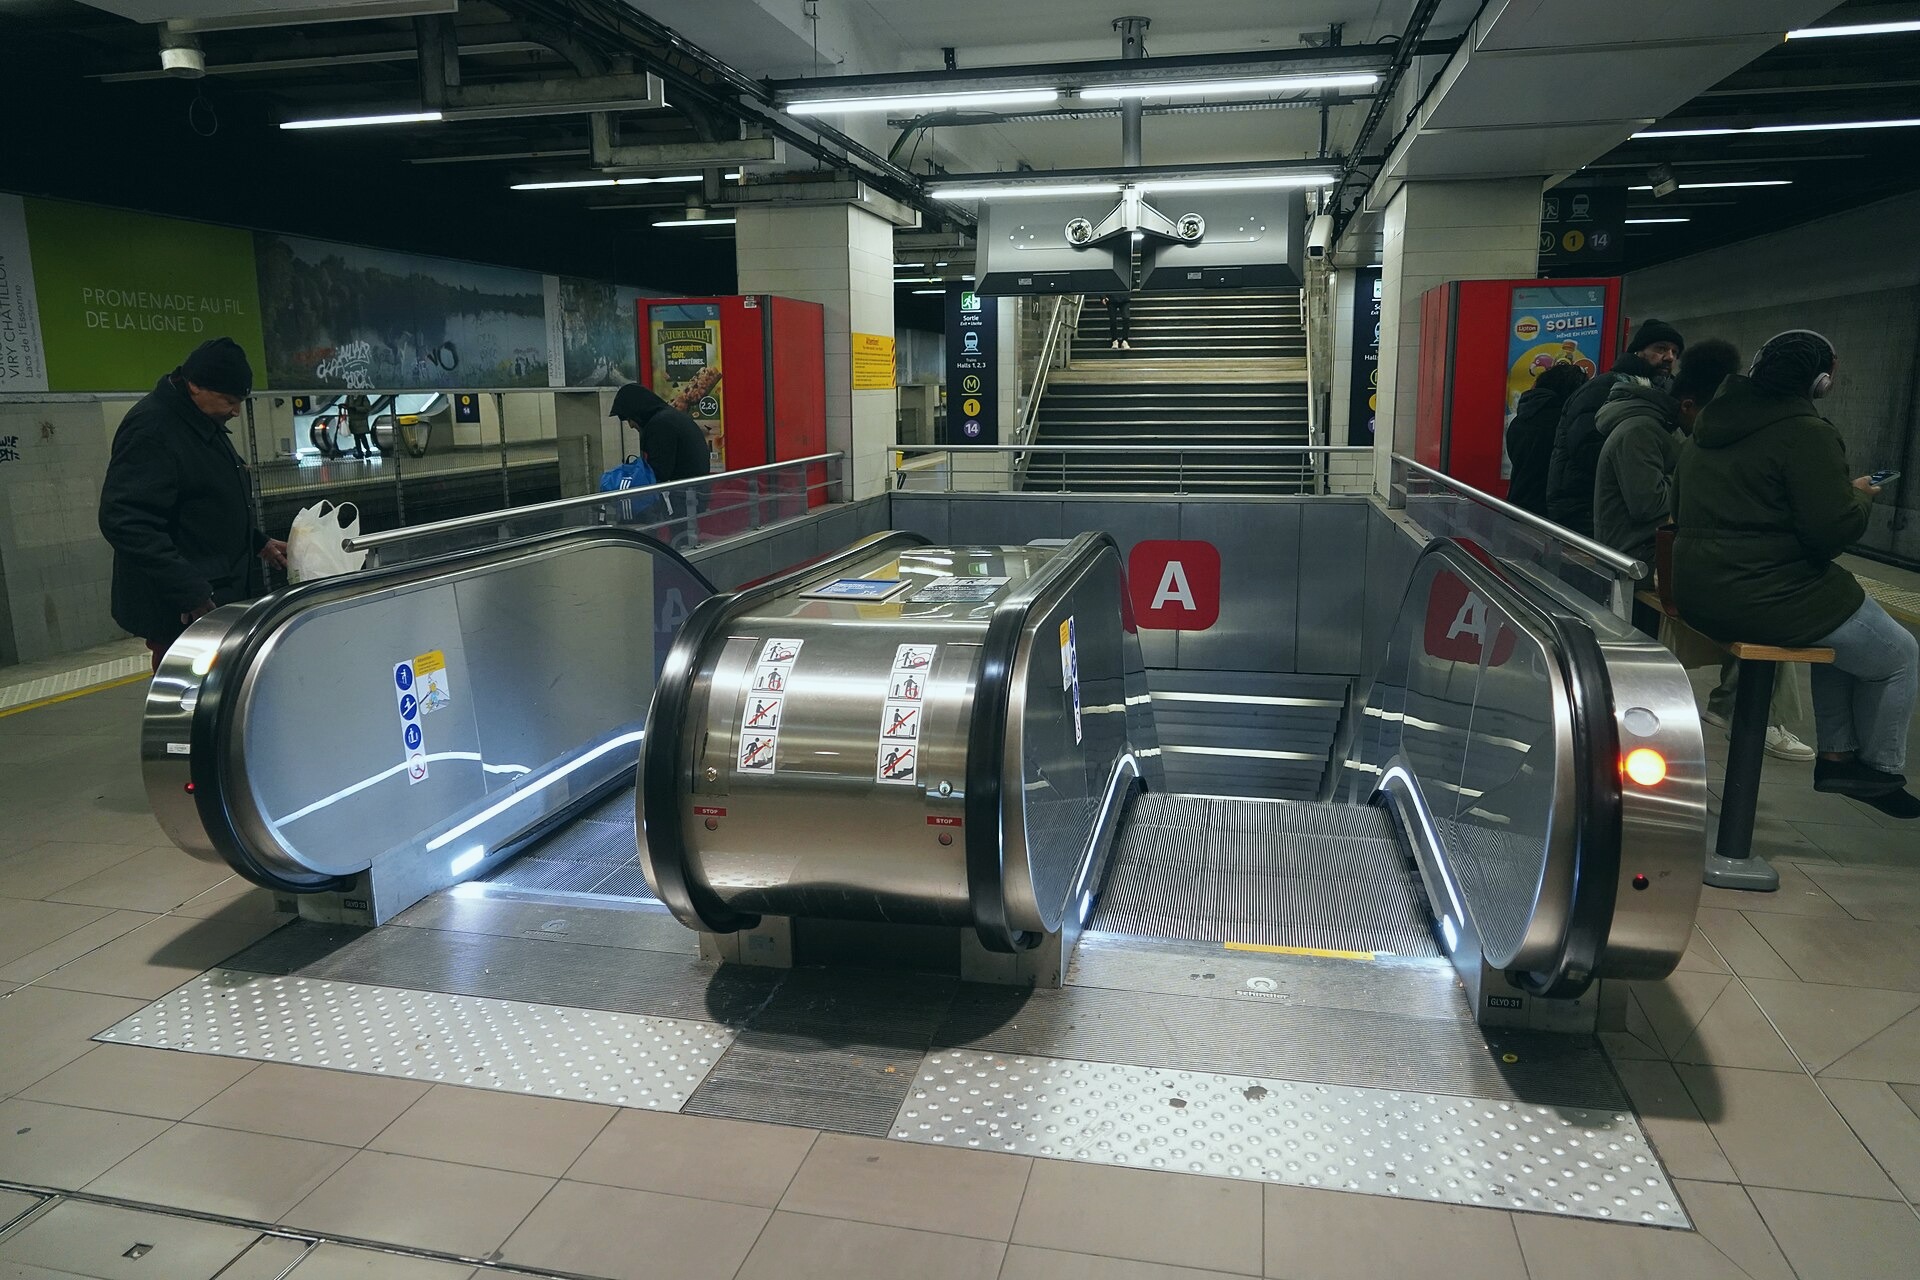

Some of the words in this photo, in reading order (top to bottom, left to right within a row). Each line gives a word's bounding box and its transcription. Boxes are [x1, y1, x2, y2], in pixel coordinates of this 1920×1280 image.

[1569, 234, 1577, 247] 1
[1591, 233, 1609, 247] 14
[83, 288, 196, 311] PROMENADE
[200, 297, 221, 314] AU
[225, 298, 245, 315] FIL
[86, 311, 110, 329] DE
[114, 313, 136, 330] LA
[139, 315, 186, 332] LIGNE
[192, 317, 204, 333] D
[962, 314, 980, 322] Sortie
[1546, 315, 1597, 331] SOLEIL
[1518, 325, 1537, 333] Lipton
[658, 330, 685, 343] NATURE
[685, 330, 711, 343] VALLEY
[21, 338, 31, 352] de
[6, 346, 20, 378] VIRY
[25, 355, 34, 378] Lacs
[968, 402, 974, 413] 1
[965, 423, 979, 434] 14
[1150, 560, 1197, 611] A
[1236, 990, 1290, 1000] Schindler
